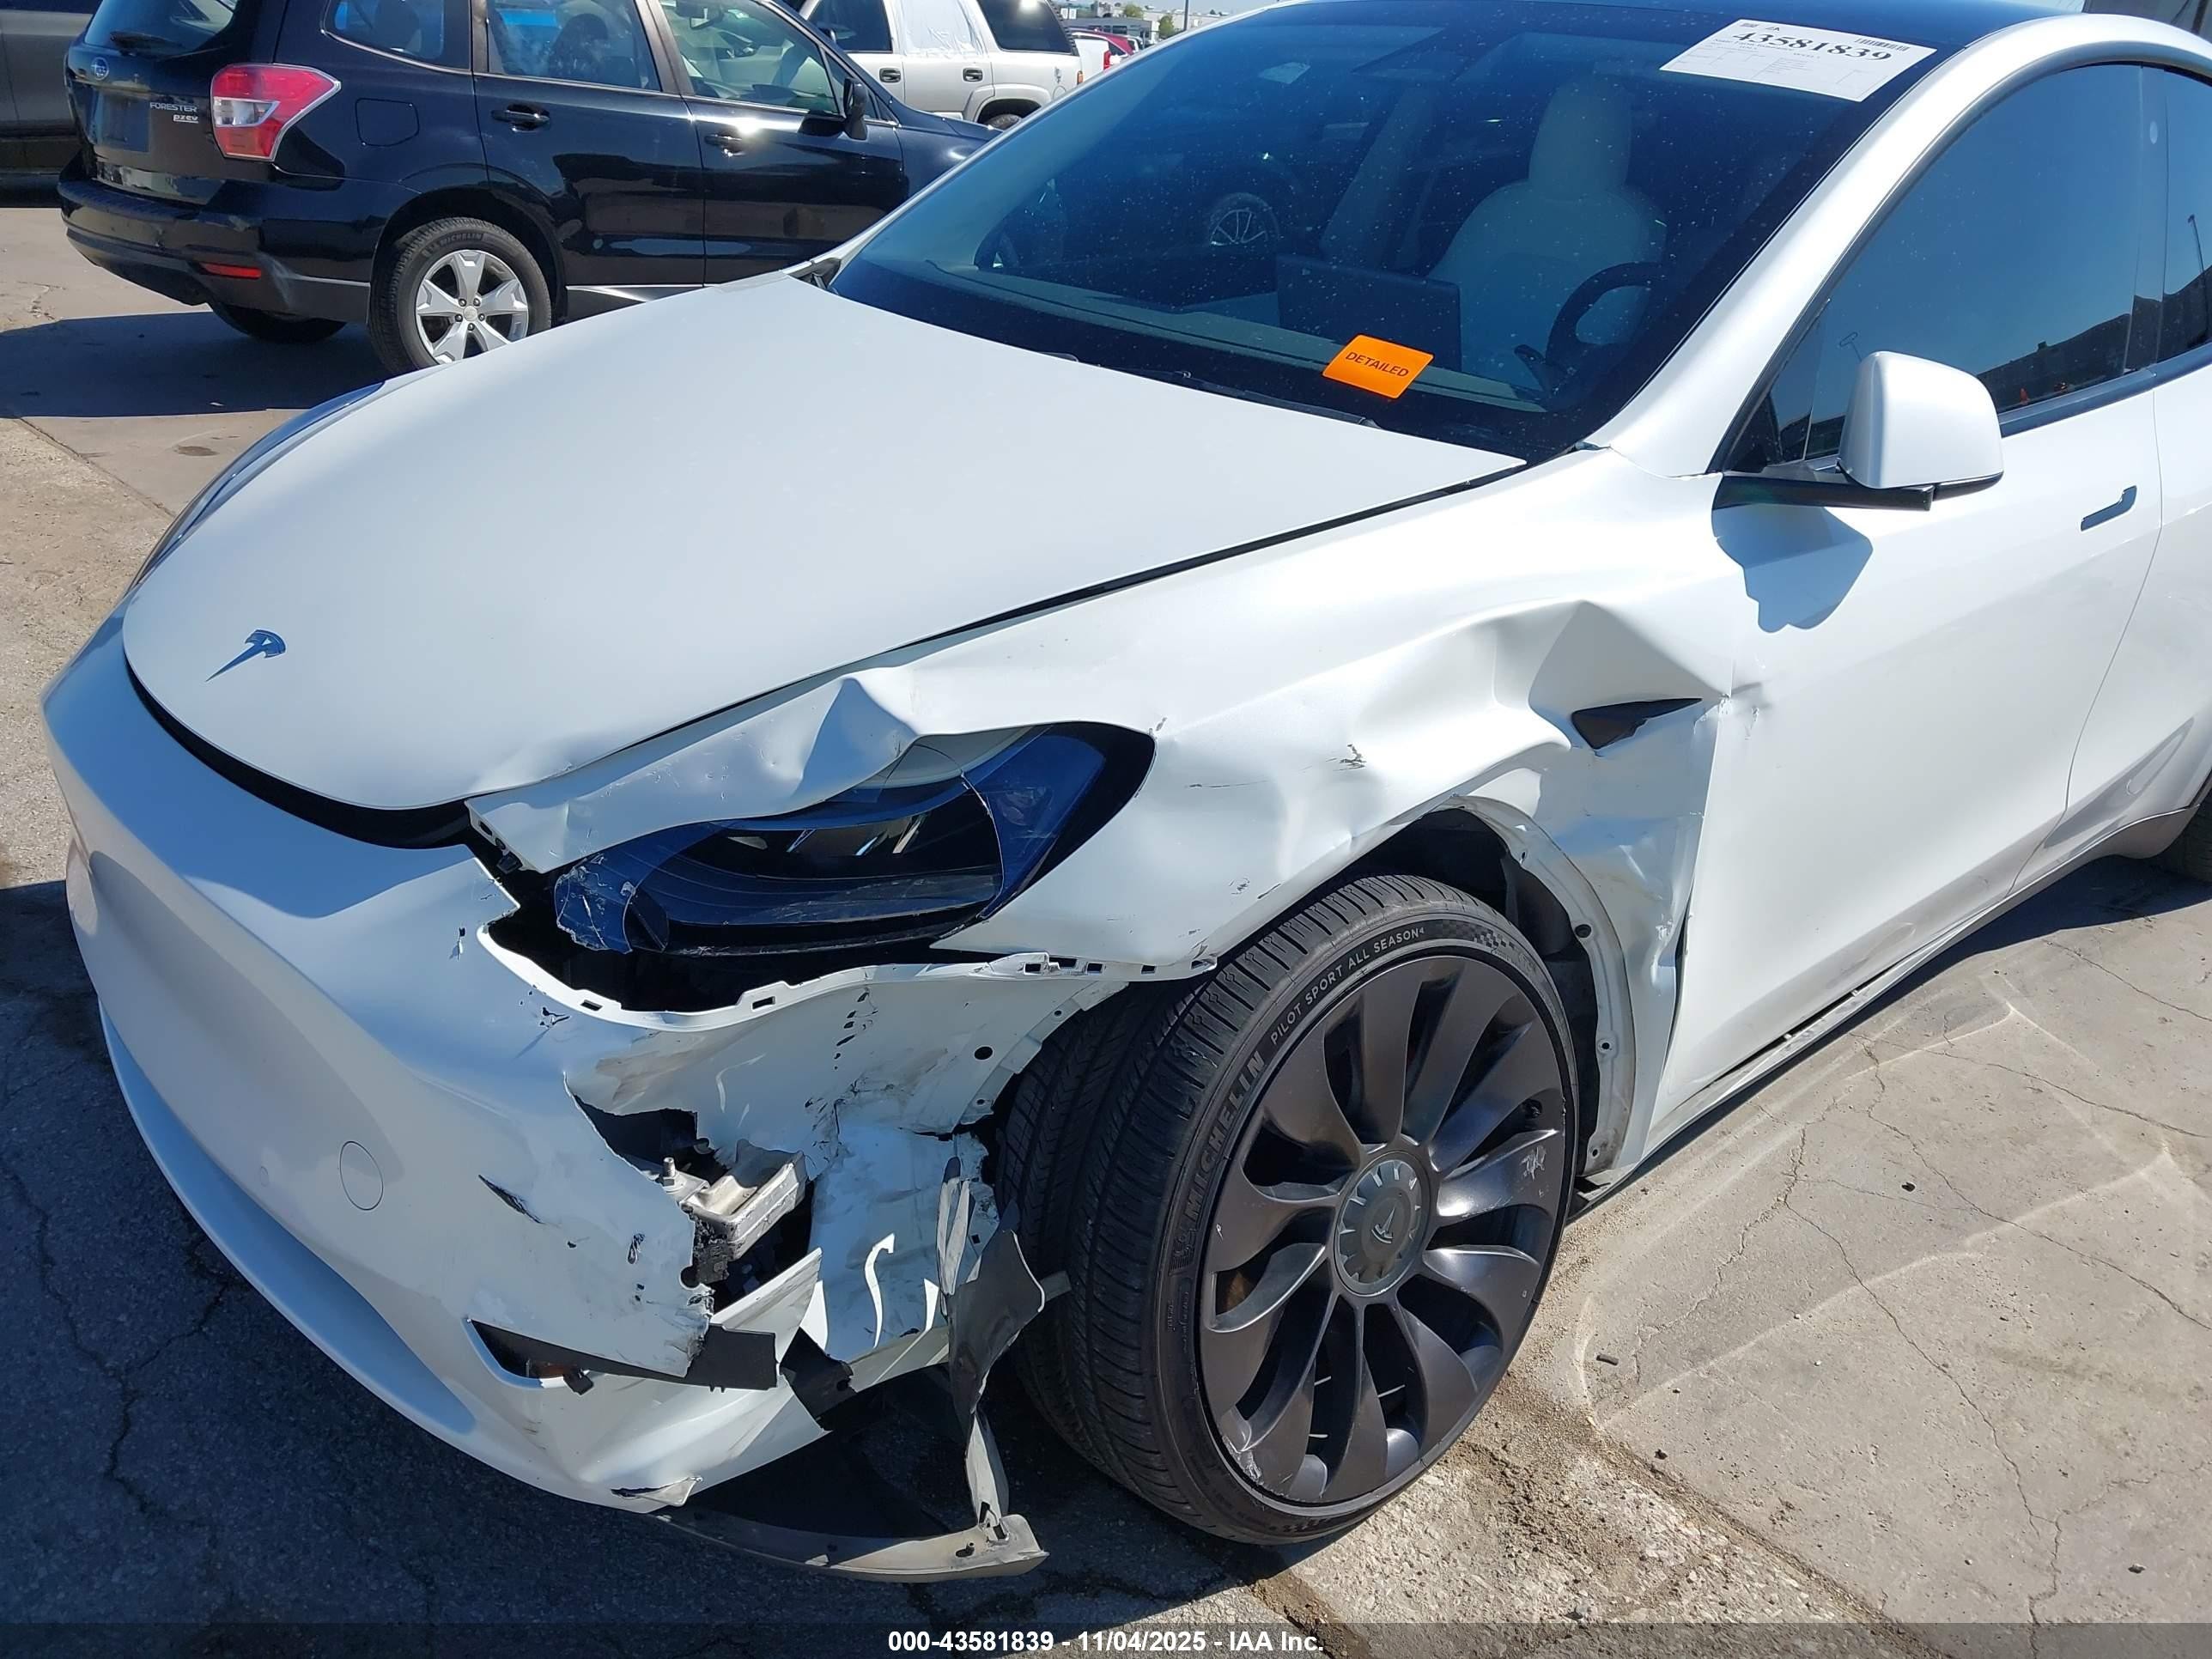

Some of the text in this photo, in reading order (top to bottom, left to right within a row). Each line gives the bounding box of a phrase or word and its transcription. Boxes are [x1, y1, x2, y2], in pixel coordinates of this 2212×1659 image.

[1732, 32, 1892, 61] 43581839
[149, 101, 198, 112] FORESTER
[439, 233, 482, 246] MICHELIN
[1345, 351, 1409, 377] DETAILED
[1270, 1003, 1303, 1045] PILOT
[1304, 964, 1344, 1006] SPORT
[1347, 949, 1370, 970] ALL
[1184, 1050, 1266, 1222] MICHELIN
